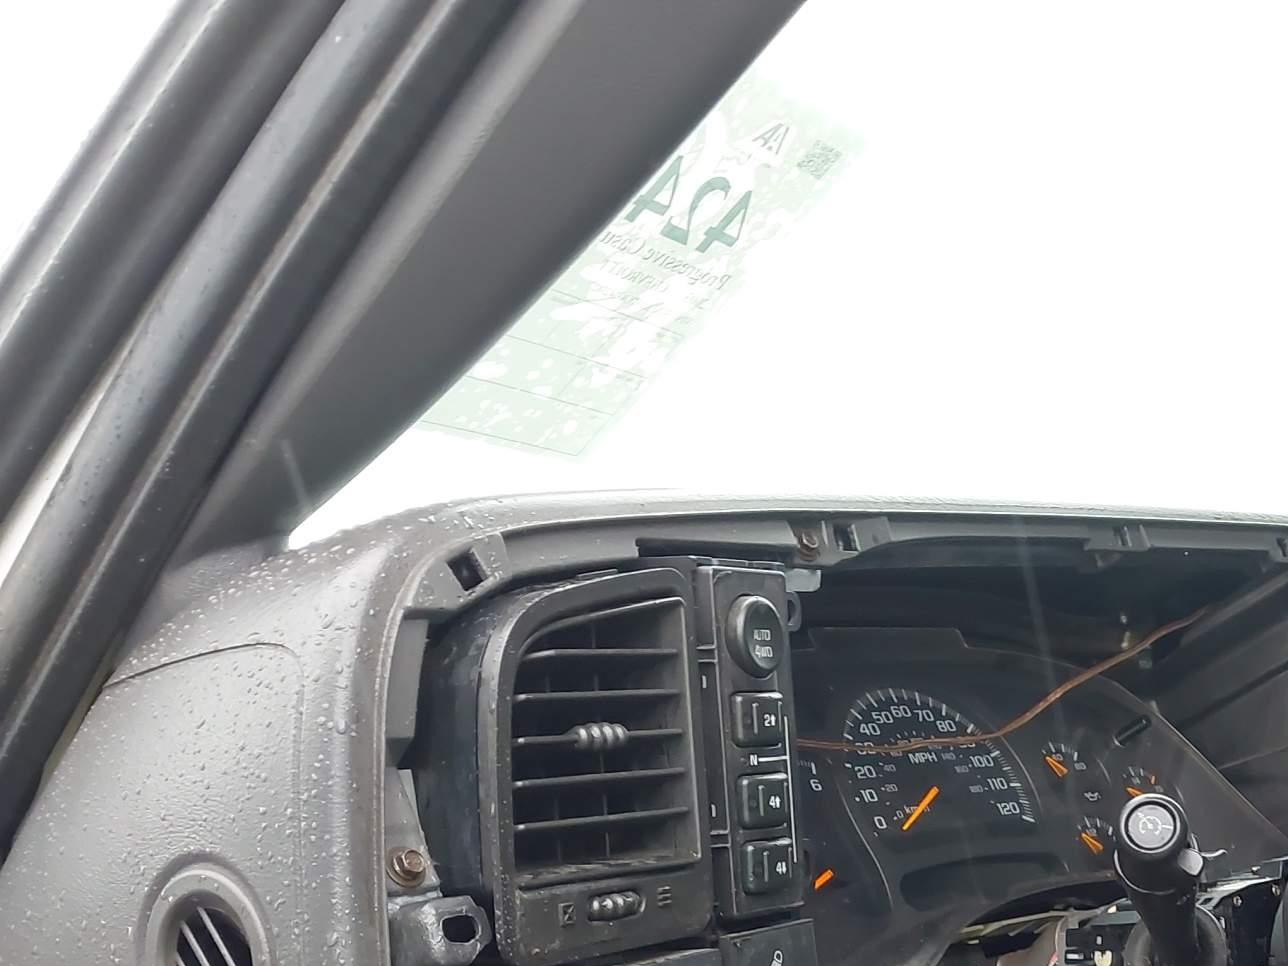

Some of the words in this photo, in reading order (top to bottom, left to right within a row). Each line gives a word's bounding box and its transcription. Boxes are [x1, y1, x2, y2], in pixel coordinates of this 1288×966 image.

[753, 629, 772, 641] AUTO
[872, 711, 894, 724] 50
[890, 705, 912, 718] 60
[913, 709, 935, 722] 70
[859, 722, 881, 736] 40
[936, 720, 957, 732] 80
[750, 754, 758, 766] N
[908, 753, 938, 766] MPH
[970, 755, 994, 768] 100
[855, 766, 877, 779] 20
[810, 778, 823, 792] 6
[987, 778, 1008, 790] 110
[860, 789, 878, 803] 10
[997, 802, 1020, 815] 120
[874, 816, 887, 829] 0
